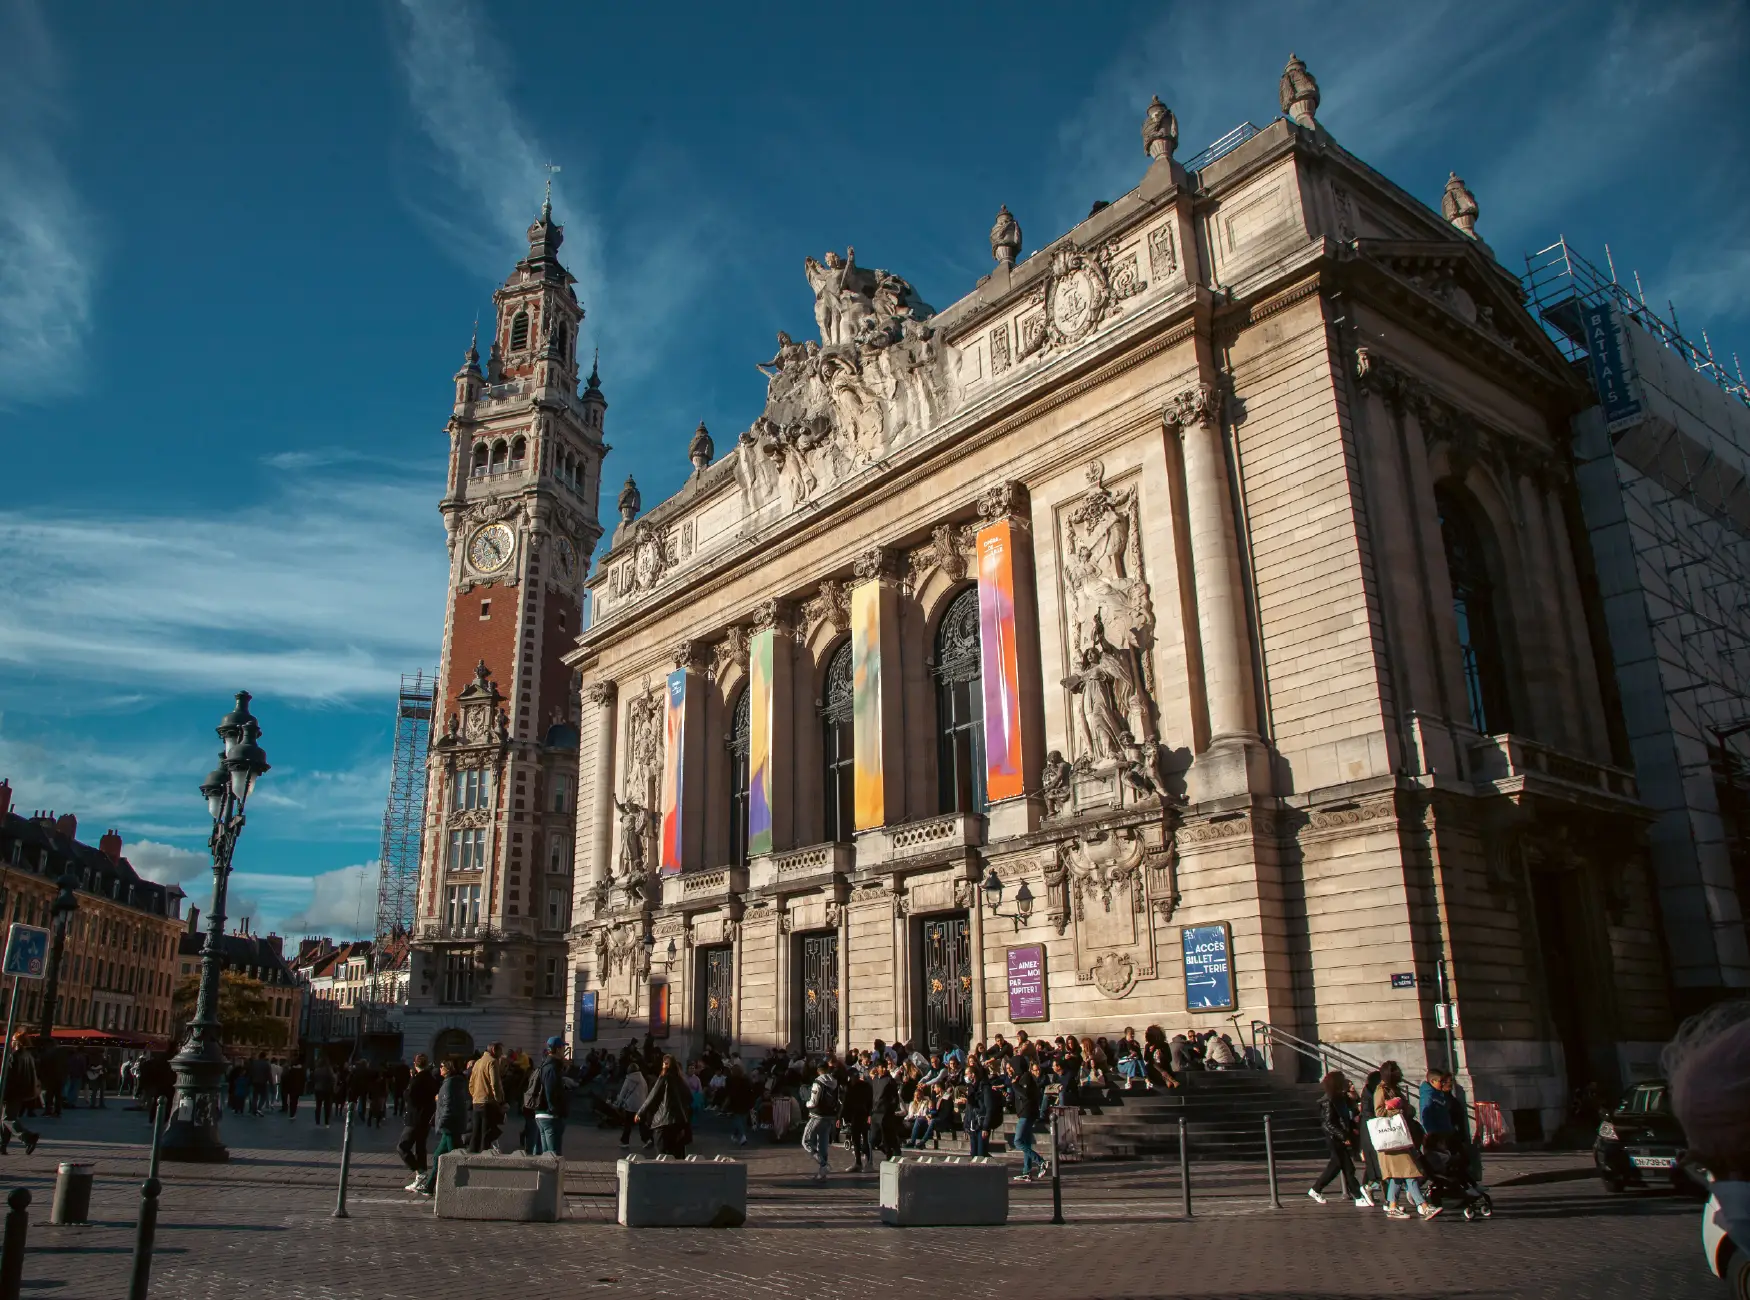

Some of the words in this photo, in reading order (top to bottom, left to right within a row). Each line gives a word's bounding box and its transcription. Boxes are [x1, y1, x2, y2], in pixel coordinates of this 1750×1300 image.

[1591, 314, 1618, 403] BATTAIS
[1195, 941, 1225, 953] ACCÈS
[1186, 954, 1213, 965] BILLET
[1027, 969, 1041, 977] MOI
[1203, 963, 1228, 973] TERIE
[1009, 979, 1022, 987] PAR
